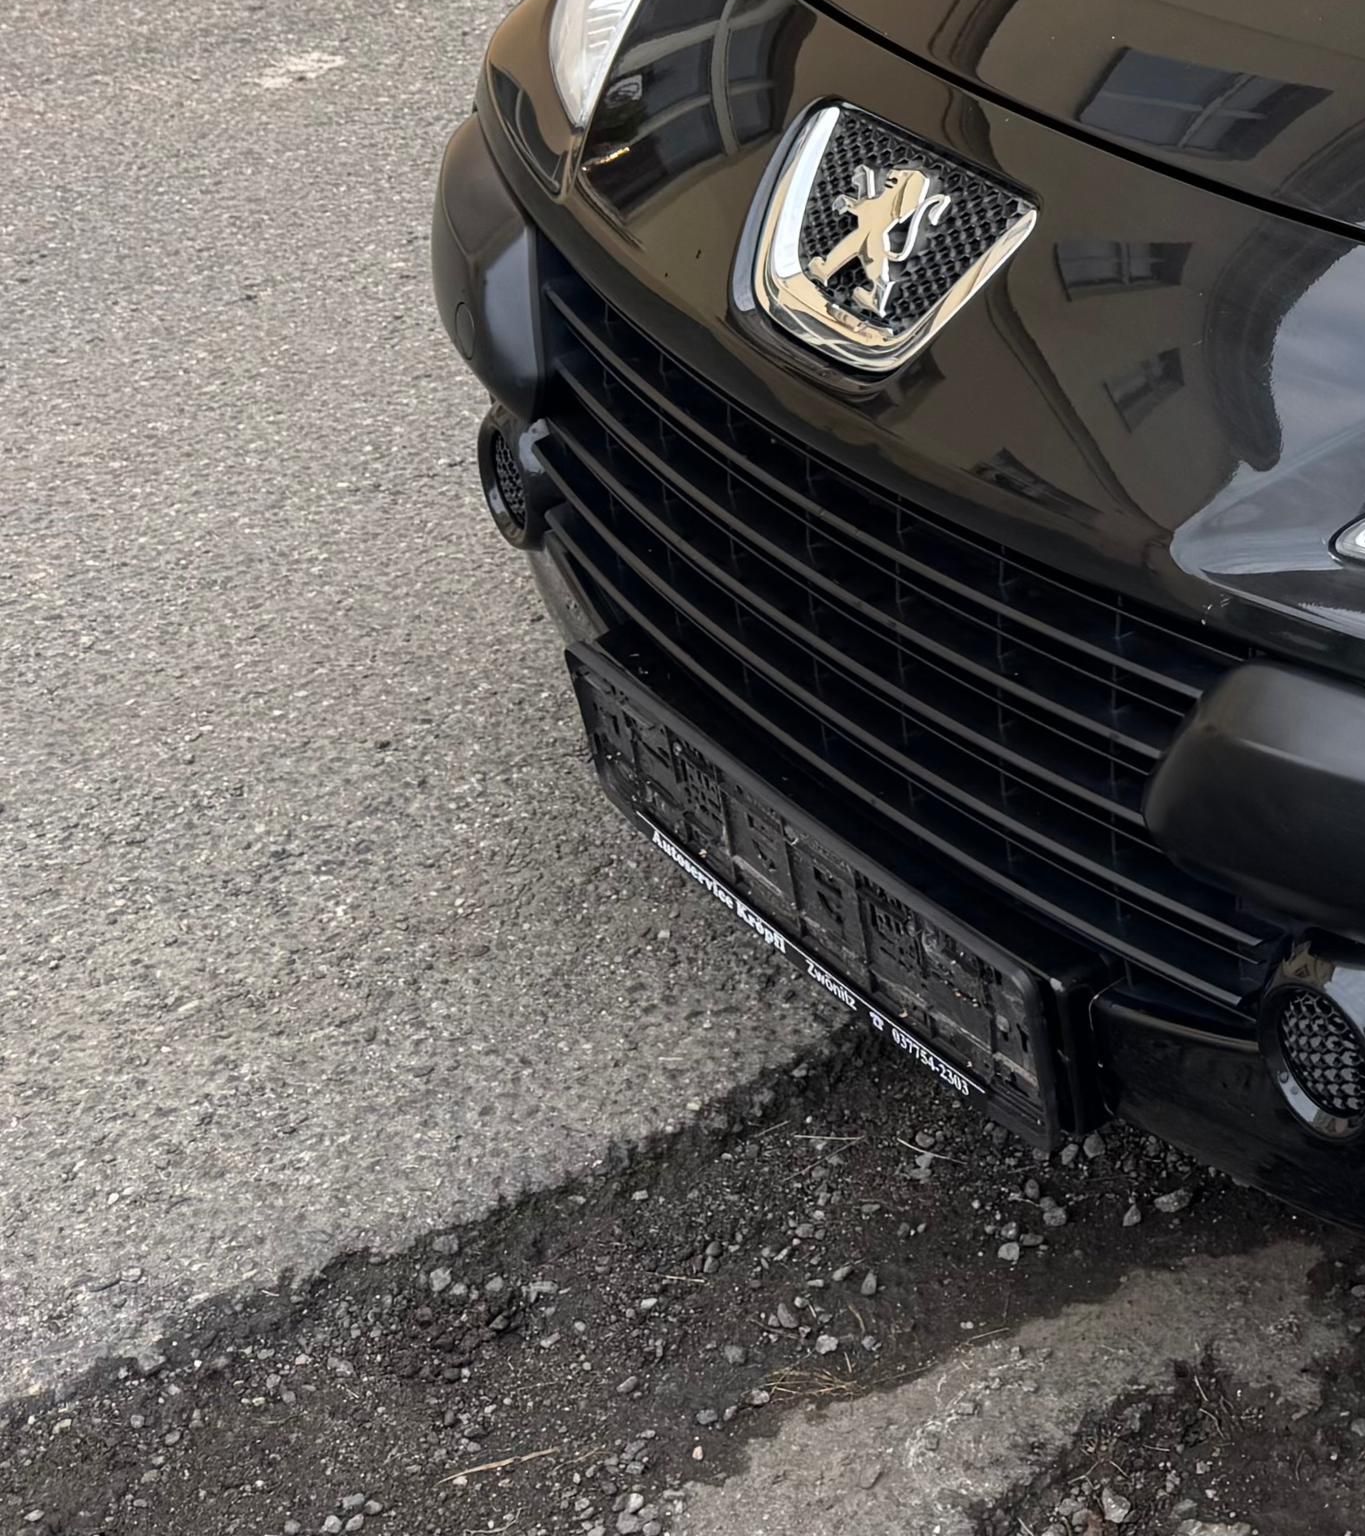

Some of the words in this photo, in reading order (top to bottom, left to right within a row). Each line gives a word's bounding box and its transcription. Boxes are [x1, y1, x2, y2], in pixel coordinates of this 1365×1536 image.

[652, 830, 734, 909] Autoservice
[805, 958, 859, 1012] Zwönitz
[891, 1027, 970, 1096] 037754-2303
